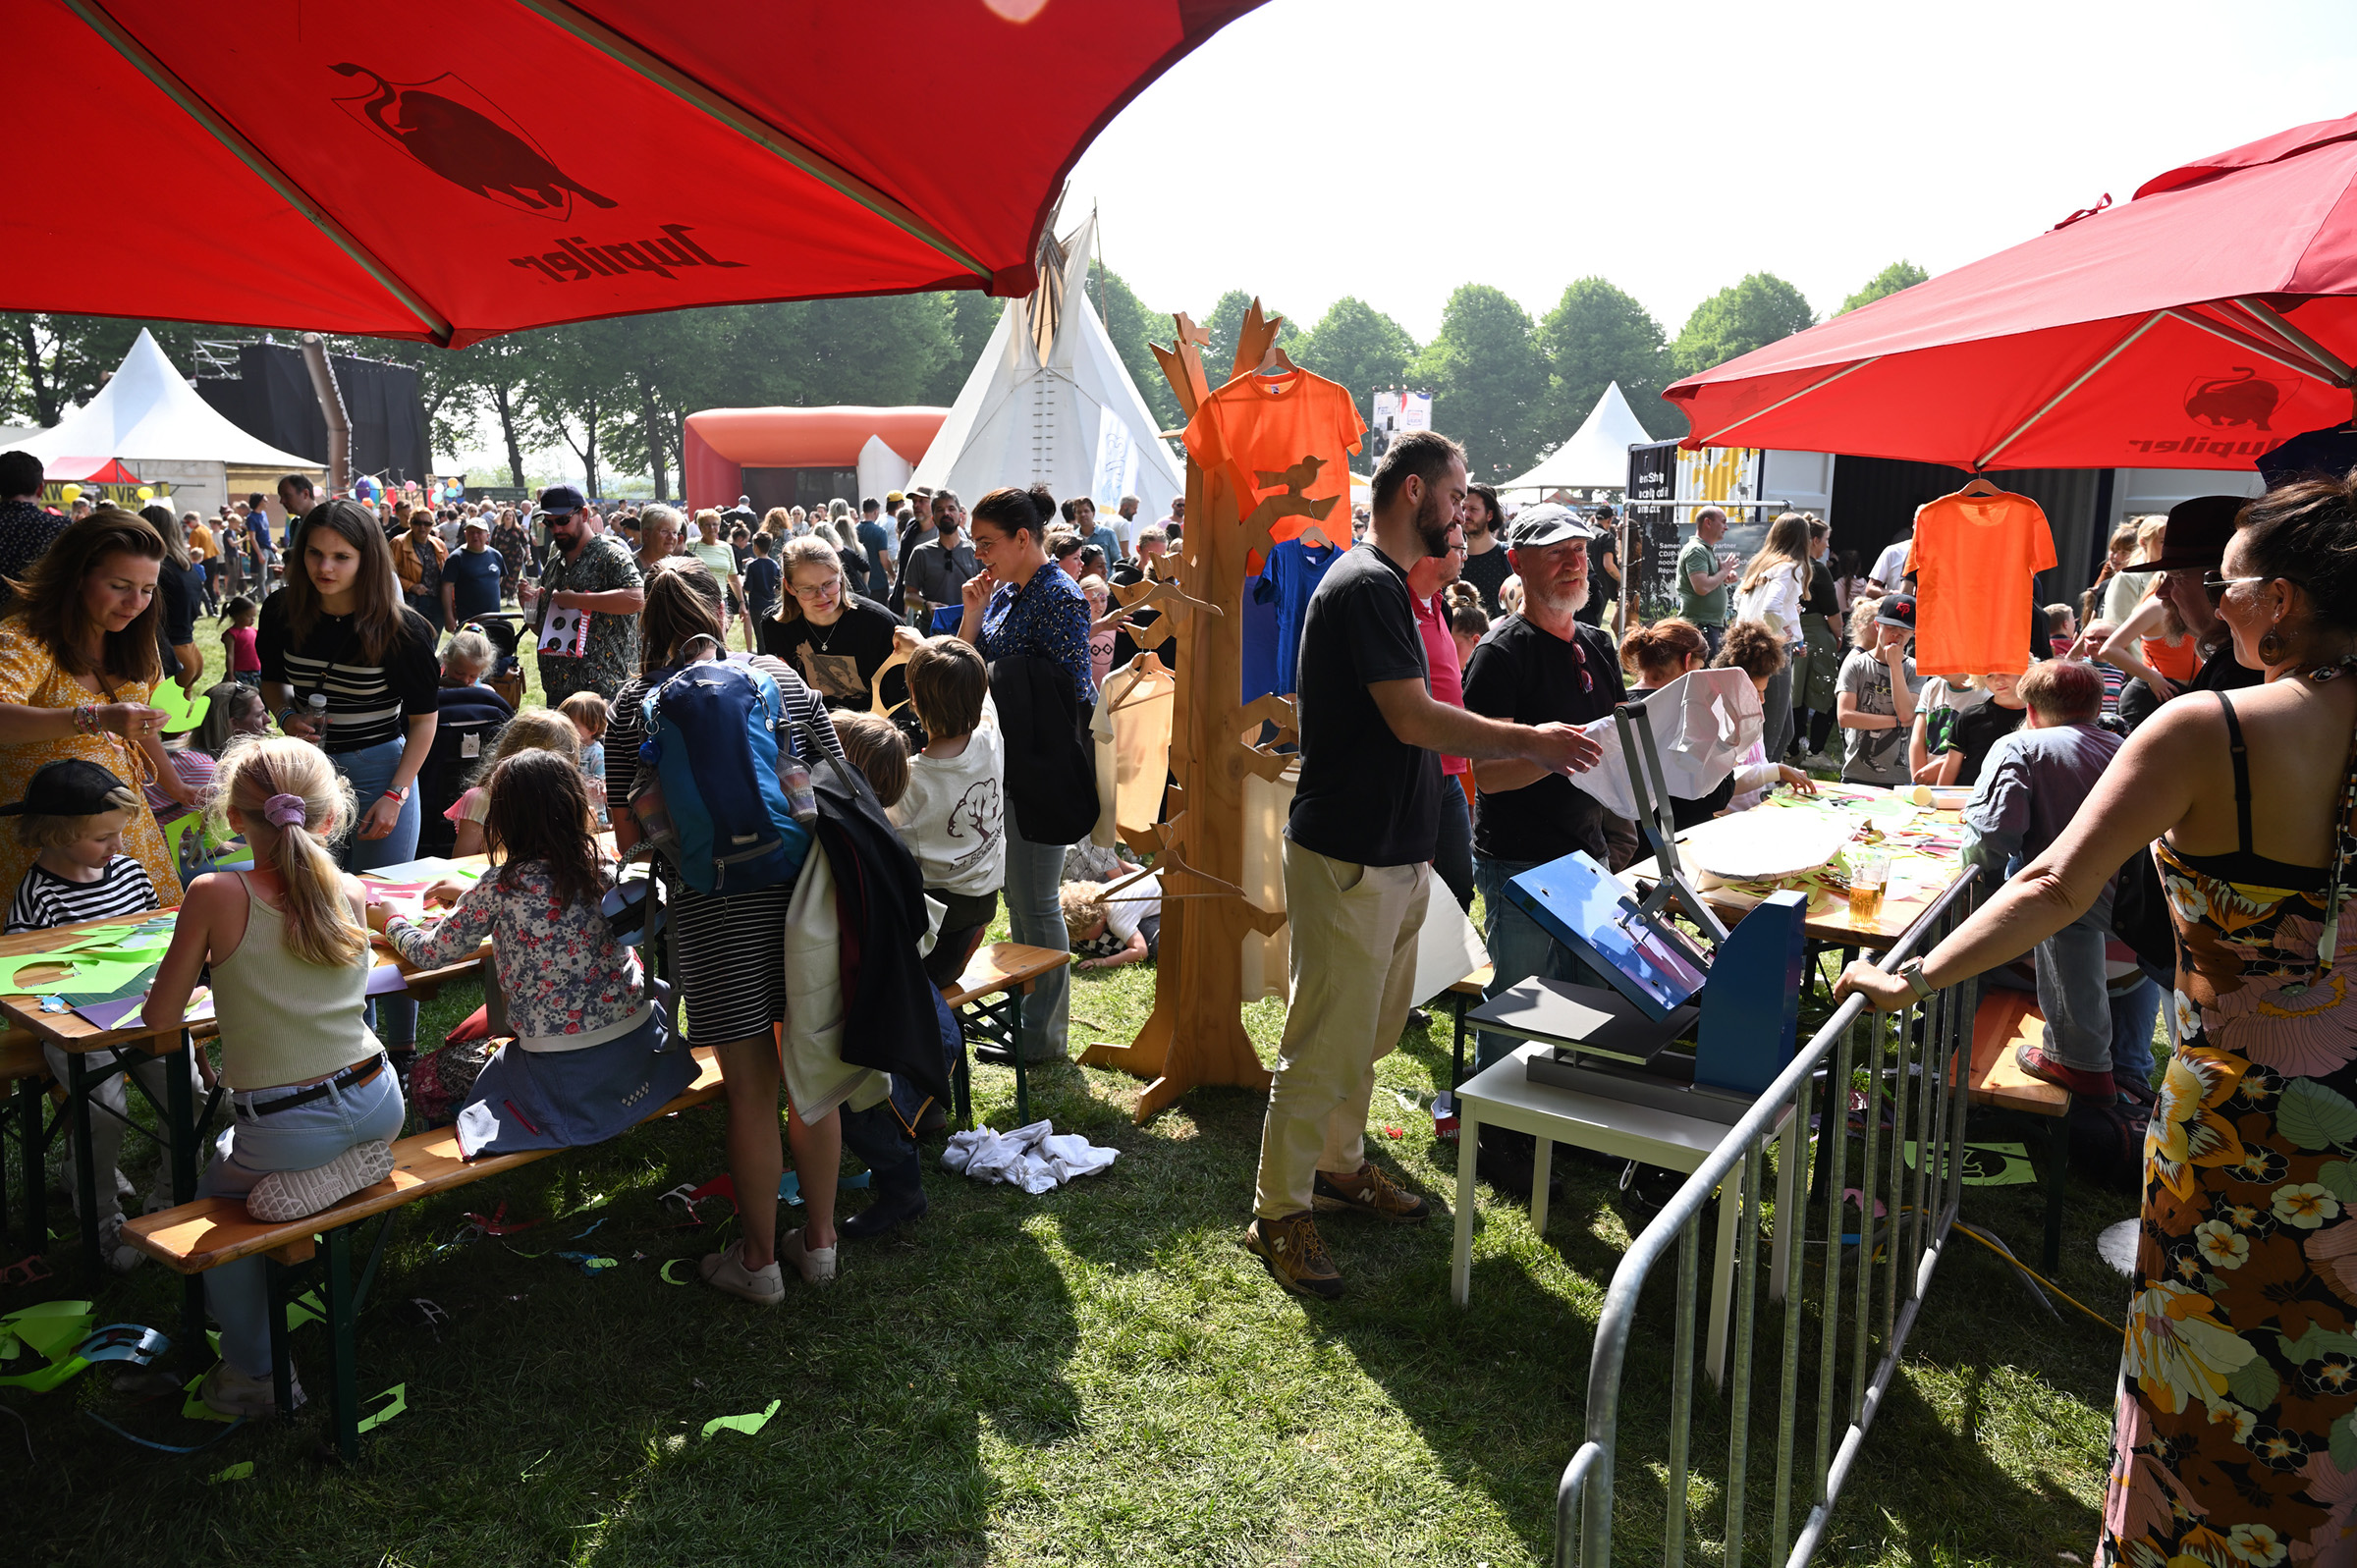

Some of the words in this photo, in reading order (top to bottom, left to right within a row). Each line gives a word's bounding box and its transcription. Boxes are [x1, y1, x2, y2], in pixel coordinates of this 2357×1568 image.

[578, 613, 591, 656] Jupiler
[1357, 1188, 1376, 1203] N
[1273, 1235, 1288, 1254] N
